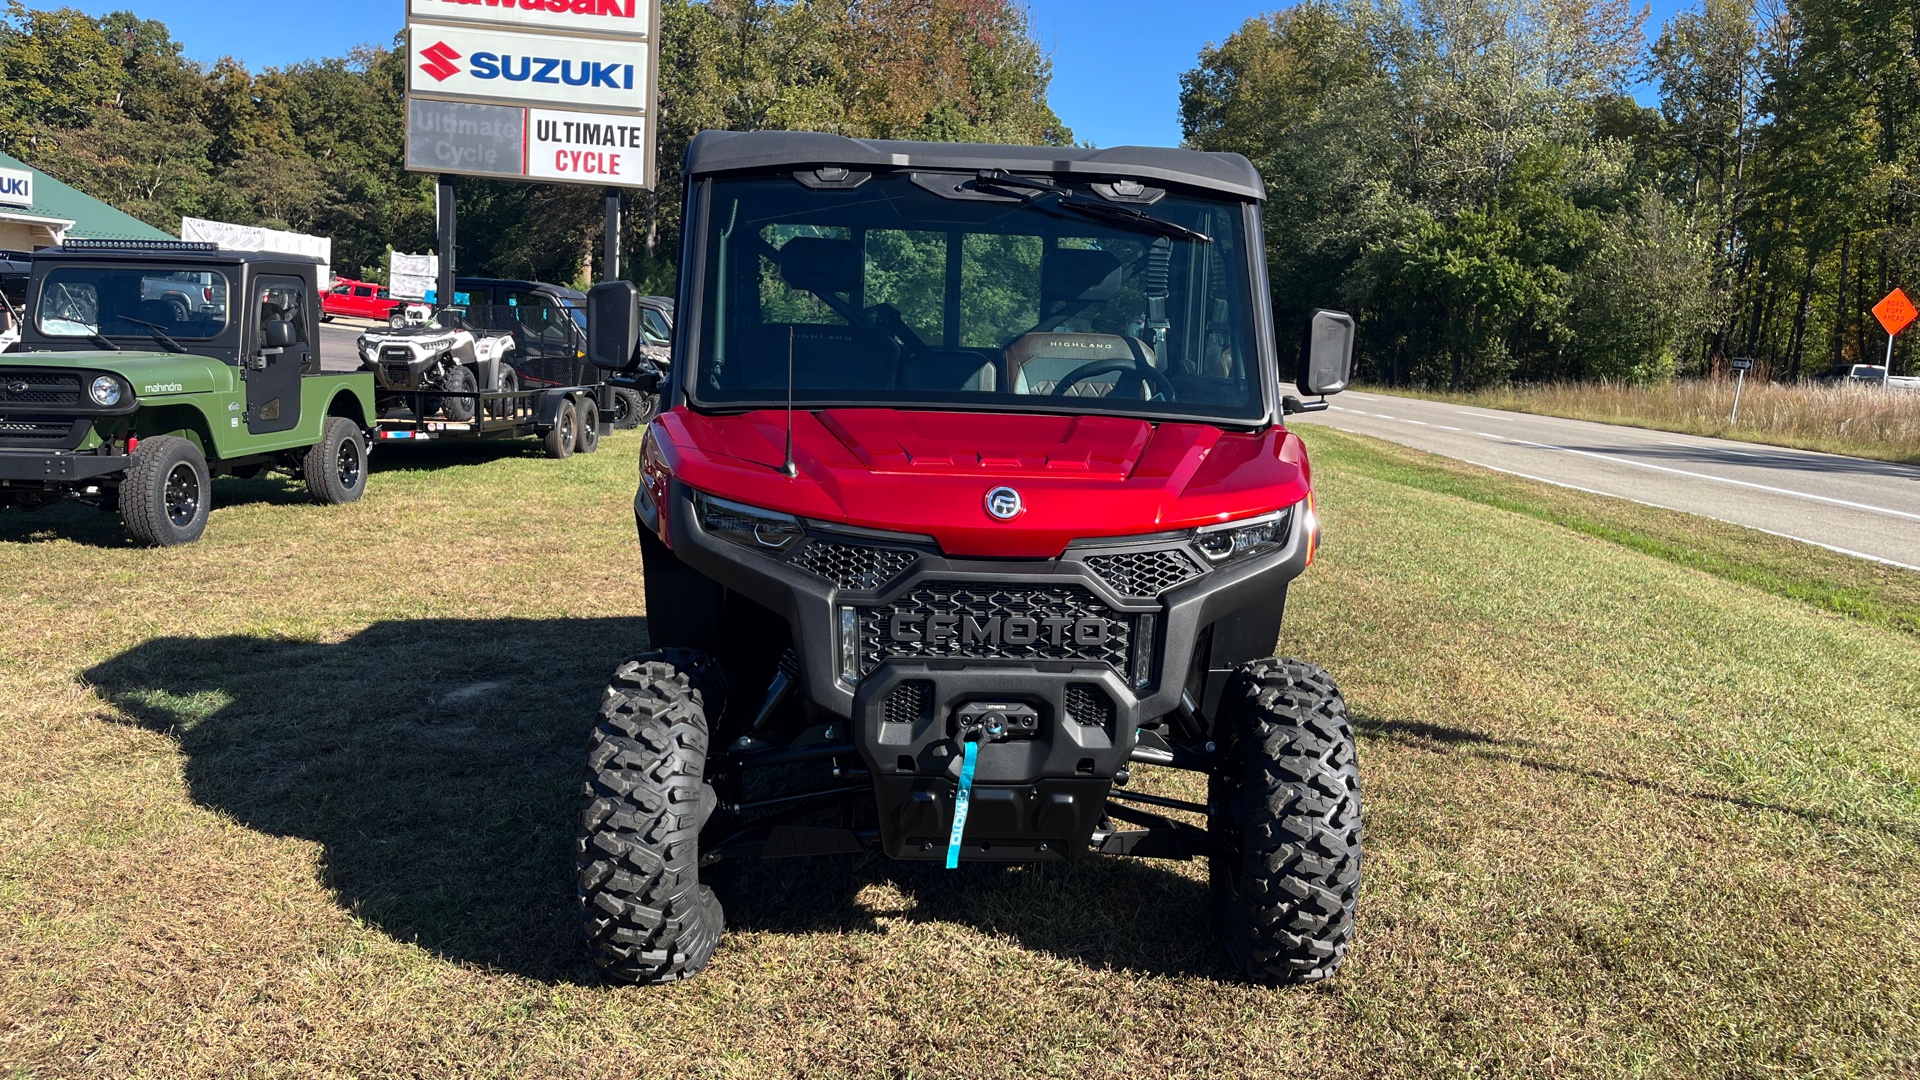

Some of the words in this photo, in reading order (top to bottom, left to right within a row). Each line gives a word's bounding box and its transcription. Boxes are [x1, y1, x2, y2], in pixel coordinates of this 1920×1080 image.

[425, 0, 635, 18] saki
[469, 51, 634, 90] SUZUKI
[417, 110, 517, 139] Ultimate
[537, 119, 641, 149] ULTIMATE
[435, 140, 498, 165] Cycle
[555, 149, 621, 175] CYCLE
[1886, 307, 1904, 315] WORK
[1887, 300, 1905, 308] ROAD
[1883, 314, 1905, 322] AHEAD
[1050, 341, 1112, 349] HIGHLAND
[145, 382, 182, 393] mahindra
[890, 613, 1108, 646] CFMOTO
[951, 789, 969, 846] CFMOTO
